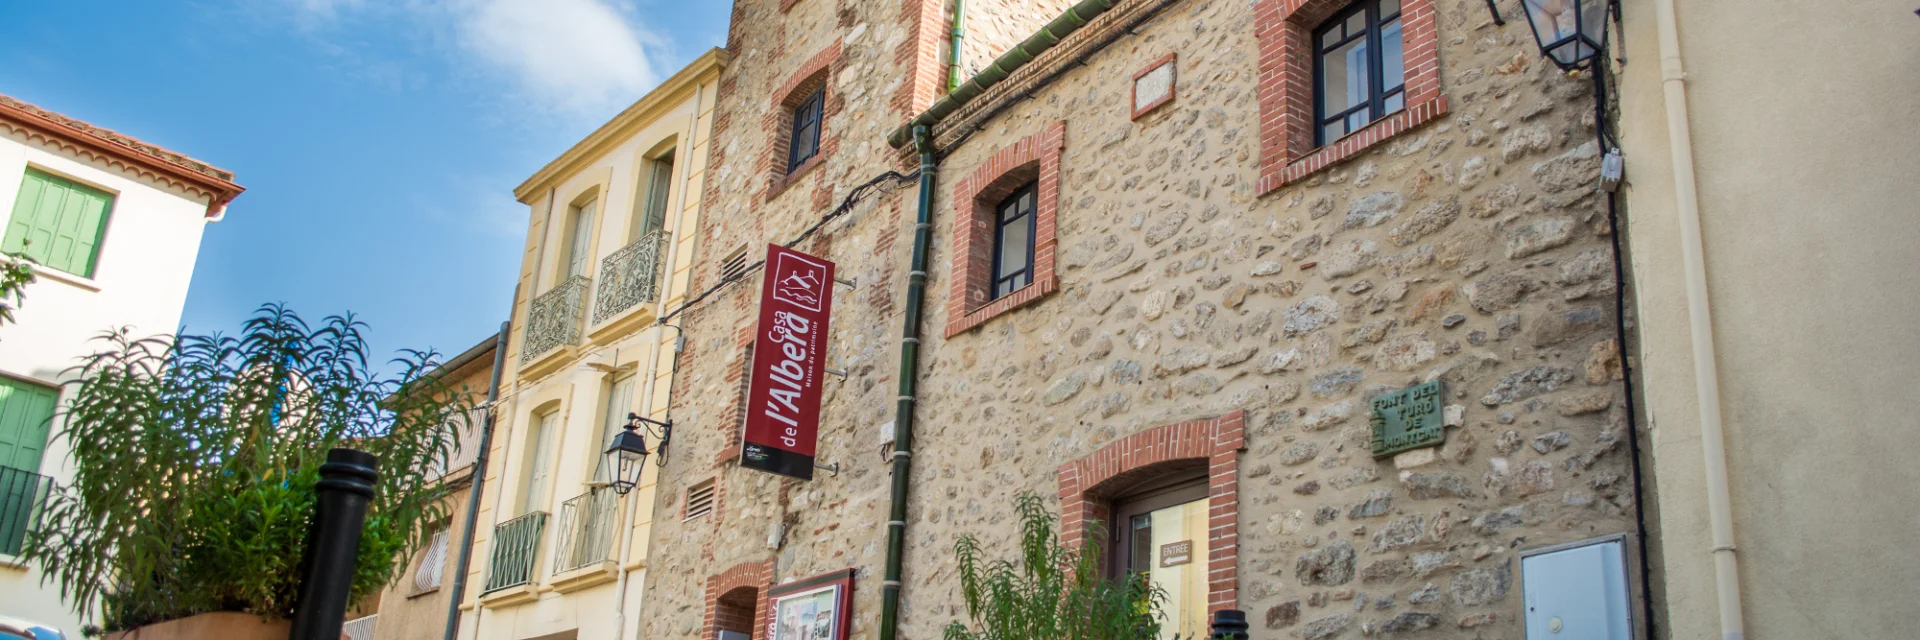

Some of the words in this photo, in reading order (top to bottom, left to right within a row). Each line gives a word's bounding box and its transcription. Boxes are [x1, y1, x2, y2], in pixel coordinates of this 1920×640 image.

[768, 311, 787, 343] Casa
[810, 321, 818, 355] patrimoine
[765, 312, 809, 427] l'Albera
[808, 356, 815, 364] du
[805, 367, 814, 388] Maison
[1373, 393, 1407, 412] FONT
[1412, 383, 1437, 400] DEL
[1404, 419, 1422, 431] DE
[780, 427, 798, 447] de
[1384, 427, 1441, 449] MONTGAT
[1163, 542, 1188, 557] ENTRÉE
